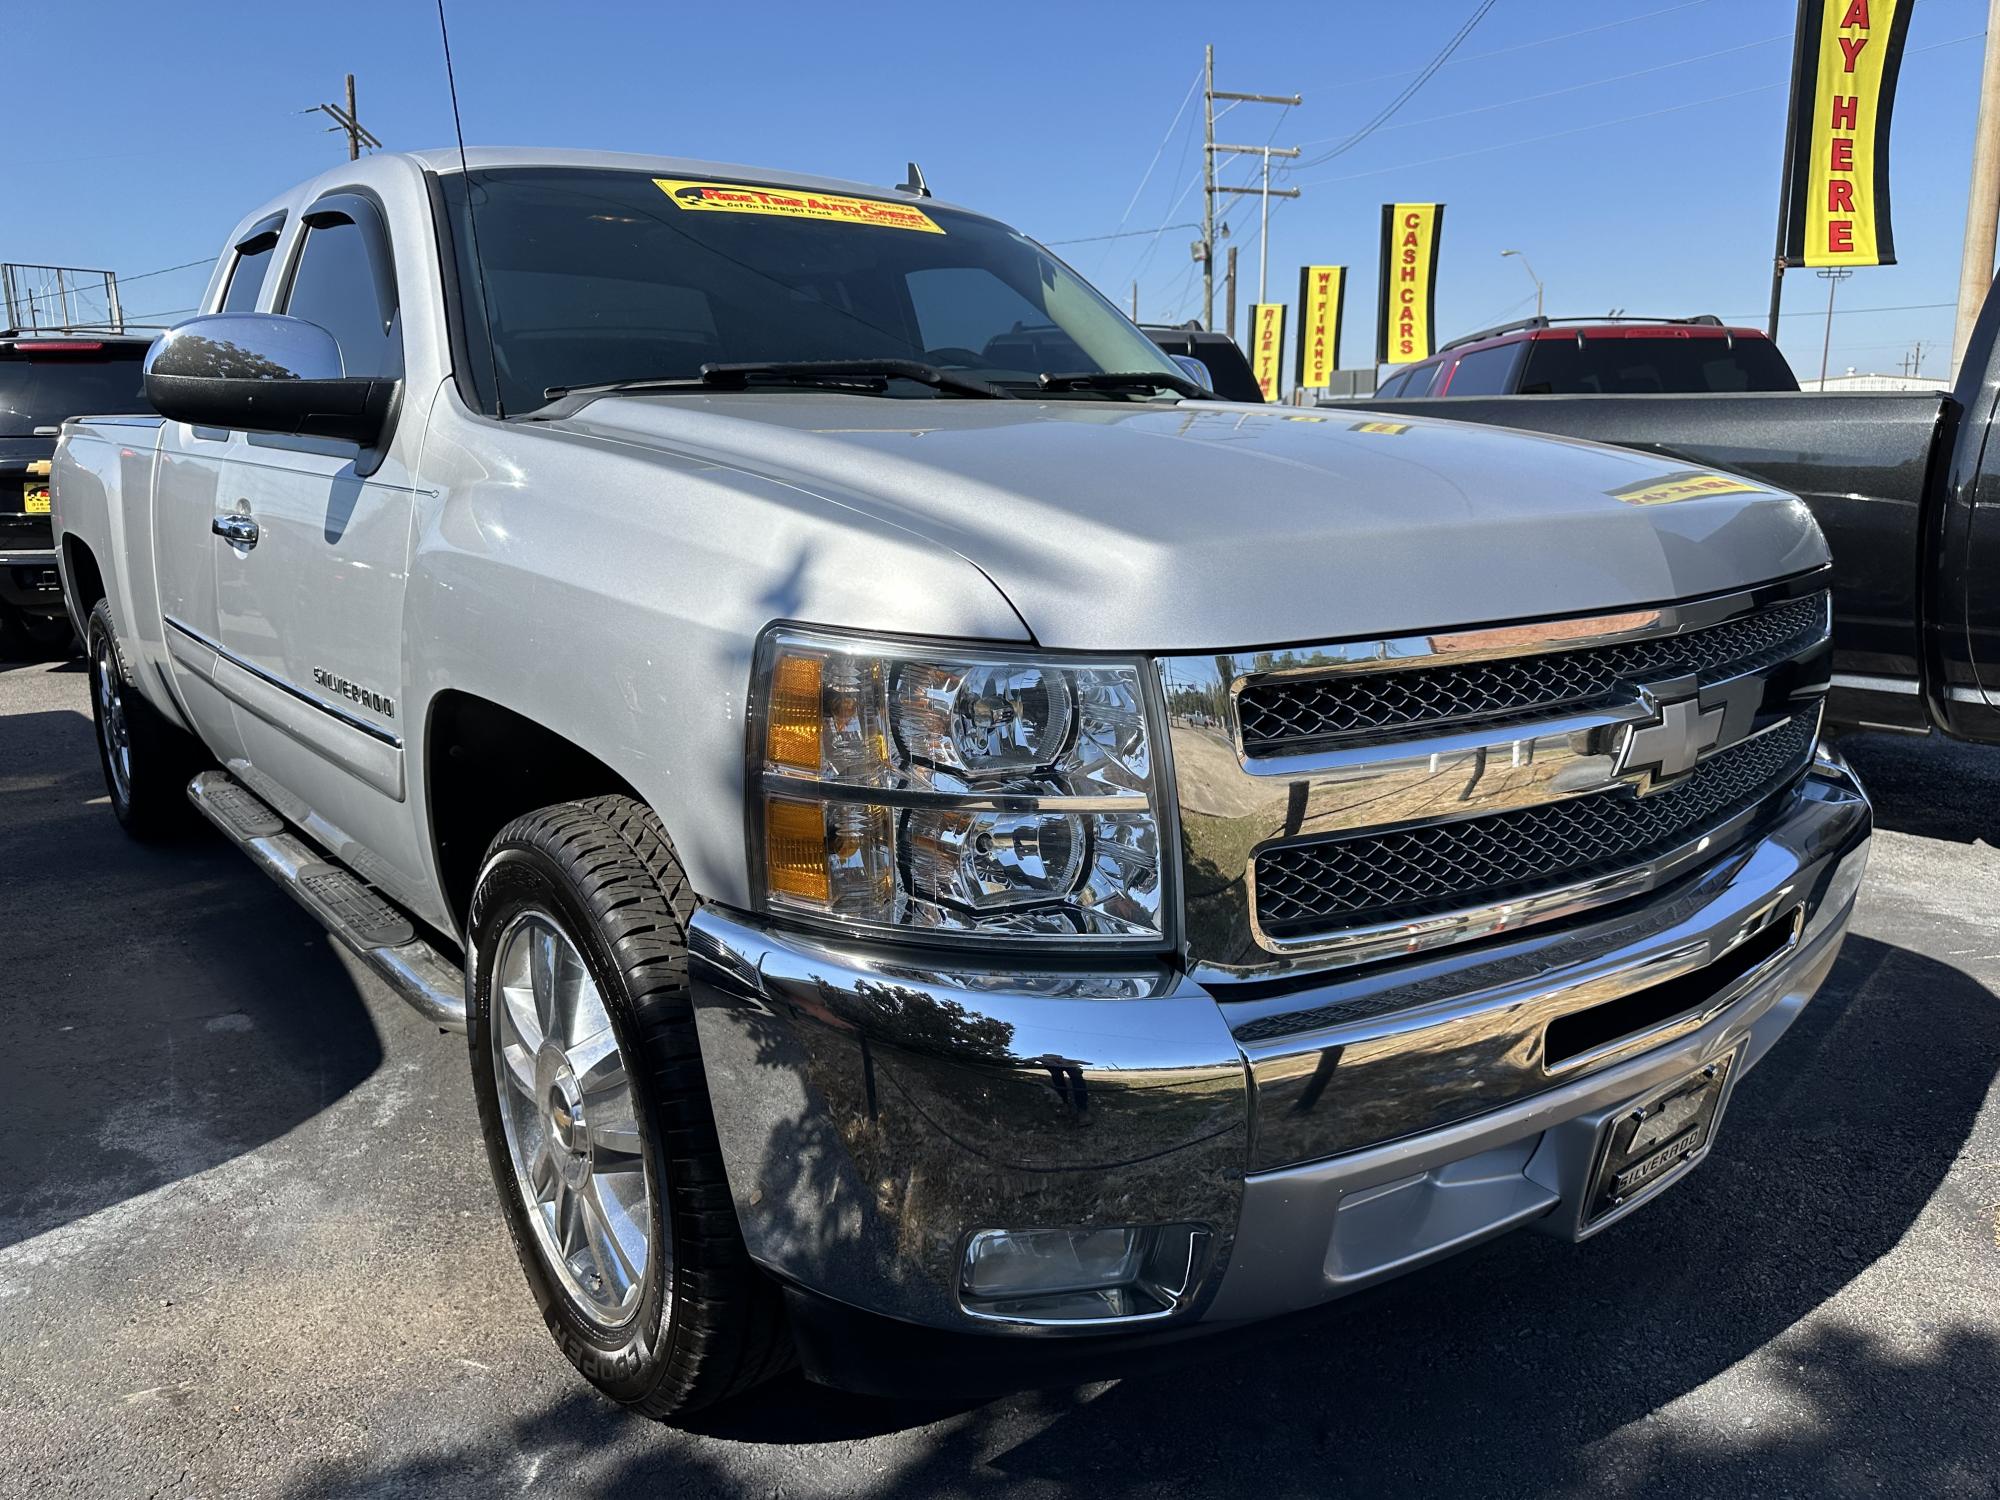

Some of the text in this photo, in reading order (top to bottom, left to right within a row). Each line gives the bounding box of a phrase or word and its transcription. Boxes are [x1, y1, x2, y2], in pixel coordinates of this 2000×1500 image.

[1828, 95, 1858, 253] HERE
[780, 206, 804, 214] Right
[808, 199, 860, 214] AUTO
[1399, 213, 1420, 355] CASH CARS
[1262, 309, 1274, 351] RIDE
[1314, 272, 1331, 382] WE FINANCE
[313, 665, 395, 719] SILVERADO
[1618, 1130, 1699, 1189] SILVERADO
